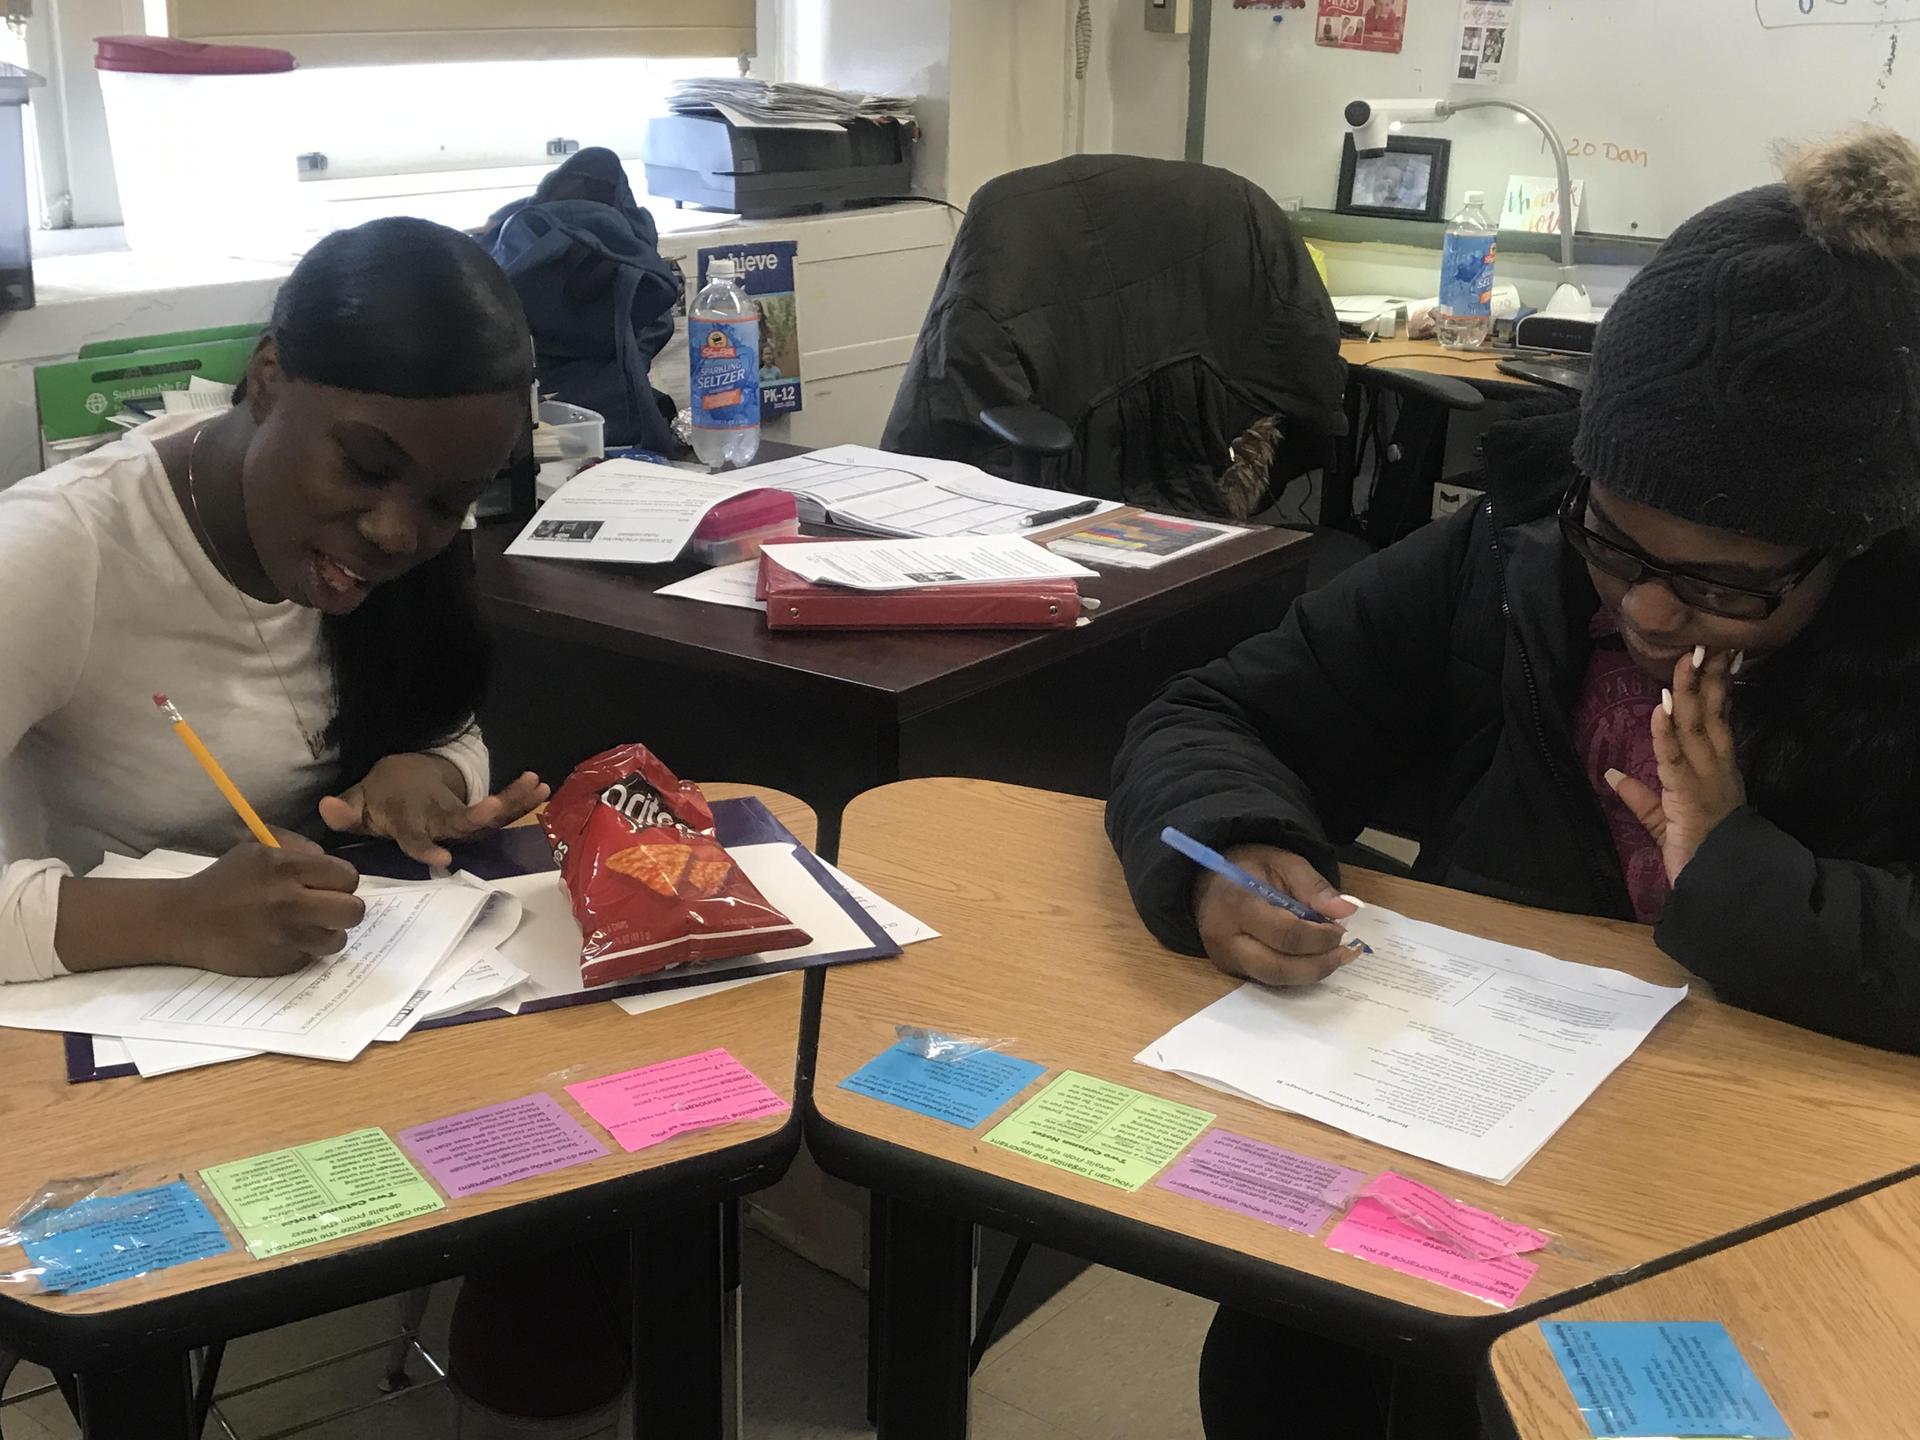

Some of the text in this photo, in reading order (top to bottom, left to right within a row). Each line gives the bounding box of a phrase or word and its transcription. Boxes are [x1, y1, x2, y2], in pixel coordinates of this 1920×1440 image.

[701, 362, 742, 376] SPARKLING
[697, 368, 745, 389] SELTZER
[763, 386, 795, 403] PK-12
[1375, 1114, 1411, 1129] Reading
[988, 1136, 1034, 1155] important
[1029, 1129, 1129, 1164] Two Column Notes
[1031, 1151, 1049, 1160] the
[1060, 1151, 1086, 1163] from
[1048, 1156, 1089, 1173] organize
[1092, 1171, 1112, 1181] can
[1109, 1177, 1135, 1189] How
[279, 1190, 398, 1227] Two Column Notes
[366, 1202, 403, 1216] details
[391, 1208, 413, 1218] can
[411, 1201, 438, 1213] How
[1237, 1201, 1262, 1212] know
[337, 1216, 384, 1233] organize
[338, 1212, 367, 1224] from
[318, 1230, 338, 1239] the
[1357, 1243, 1515, 1299] Determining Importance as you
